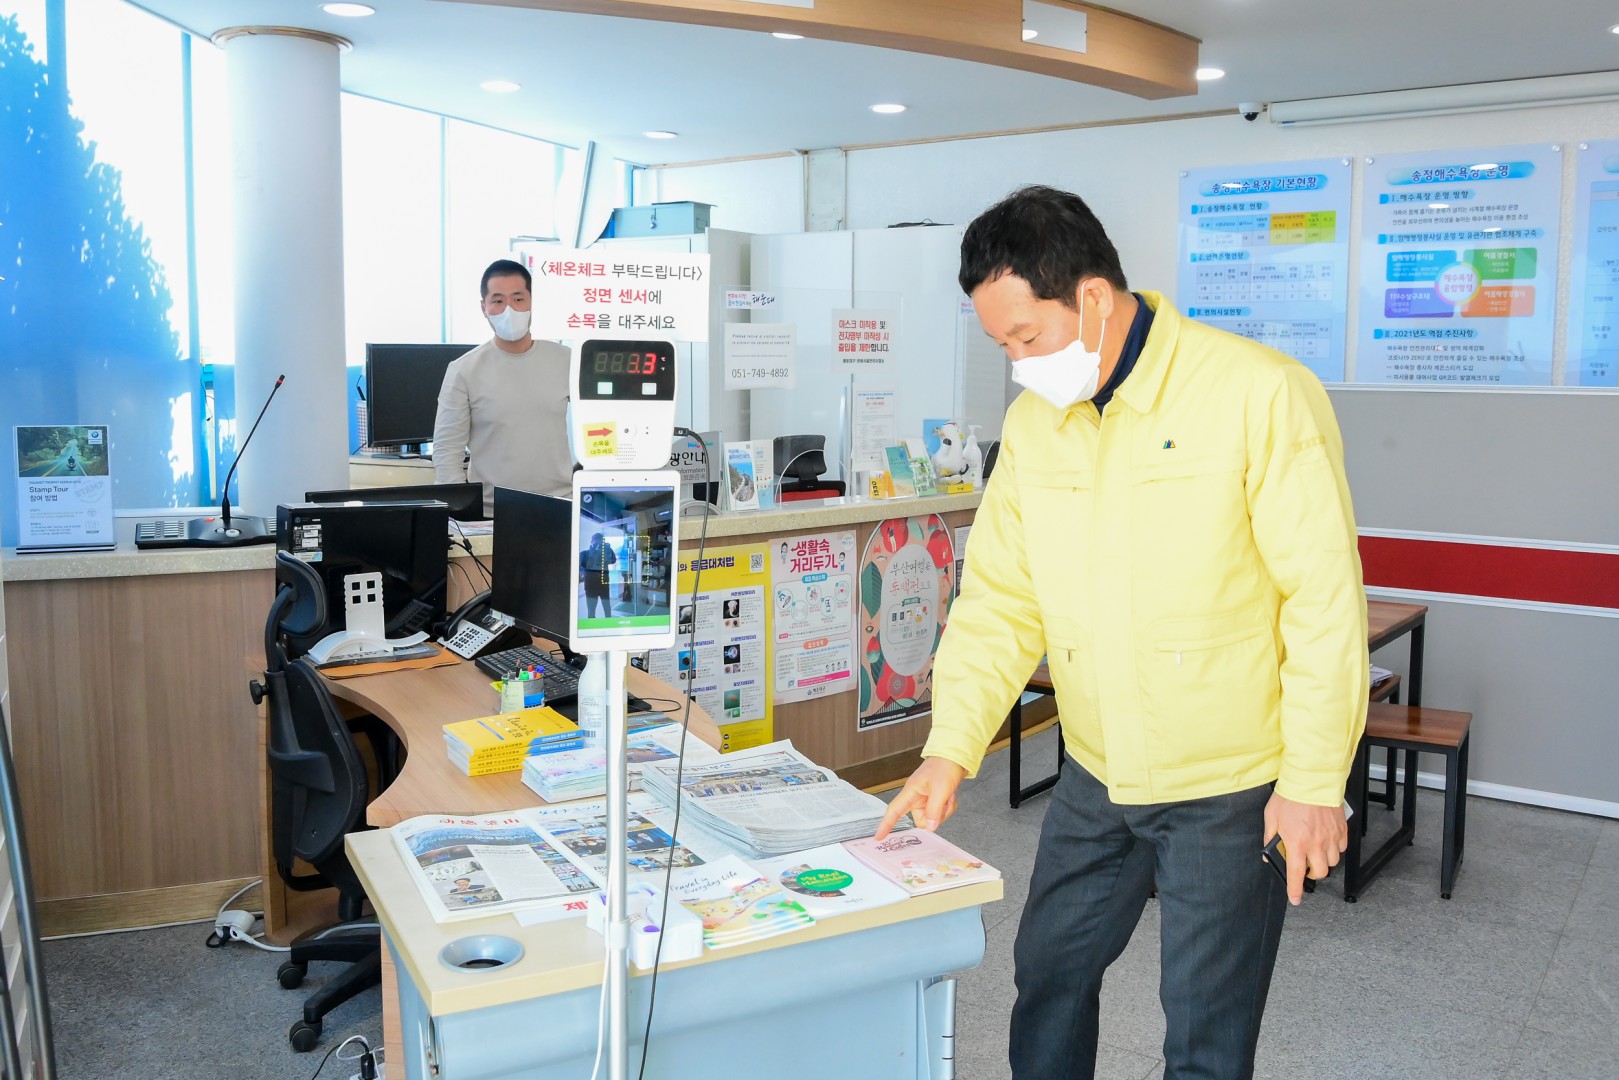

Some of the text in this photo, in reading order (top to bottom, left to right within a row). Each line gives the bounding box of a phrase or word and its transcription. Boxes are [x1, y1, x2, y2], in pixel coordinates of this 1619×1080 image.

[1411, 166, 1480, 182] 송정해수욕장
[1276, 176, 1317, 189] 기본현황
[1434, 192, 1449, 200] 운영
[1452, 190, 1469, 199] 방향
[1444, 232, 1456, 241] 운영
[1524, 229, 1537, 237] 구축
[583, 288, 662, 304] 정면 센서에
[752, 294, 775, 306] 해운대
[566, 313, 676, 330] 손목을 대주세요
[838, 320, 857, 329] 마스크
[880, 321, 886, 329] 및
[838, 332, 861, 341] 전자명부
[884, 332, 889, 341] 시
[1445, 330, 1473, 338] 추진사항
[838, 343, 856, 352] 출입을
[732, 368, 789, 378] 051-749-4892
[791, 538, 830, 556] 생활속
[691, 556, 734, 571] 응급대처법
[790, 554, 838, 573] 거리두기
[890, 558, 931, 576] 부산여행은
[722, 871, 737, 881] Life
[670, 878, 698, 891] Travel
